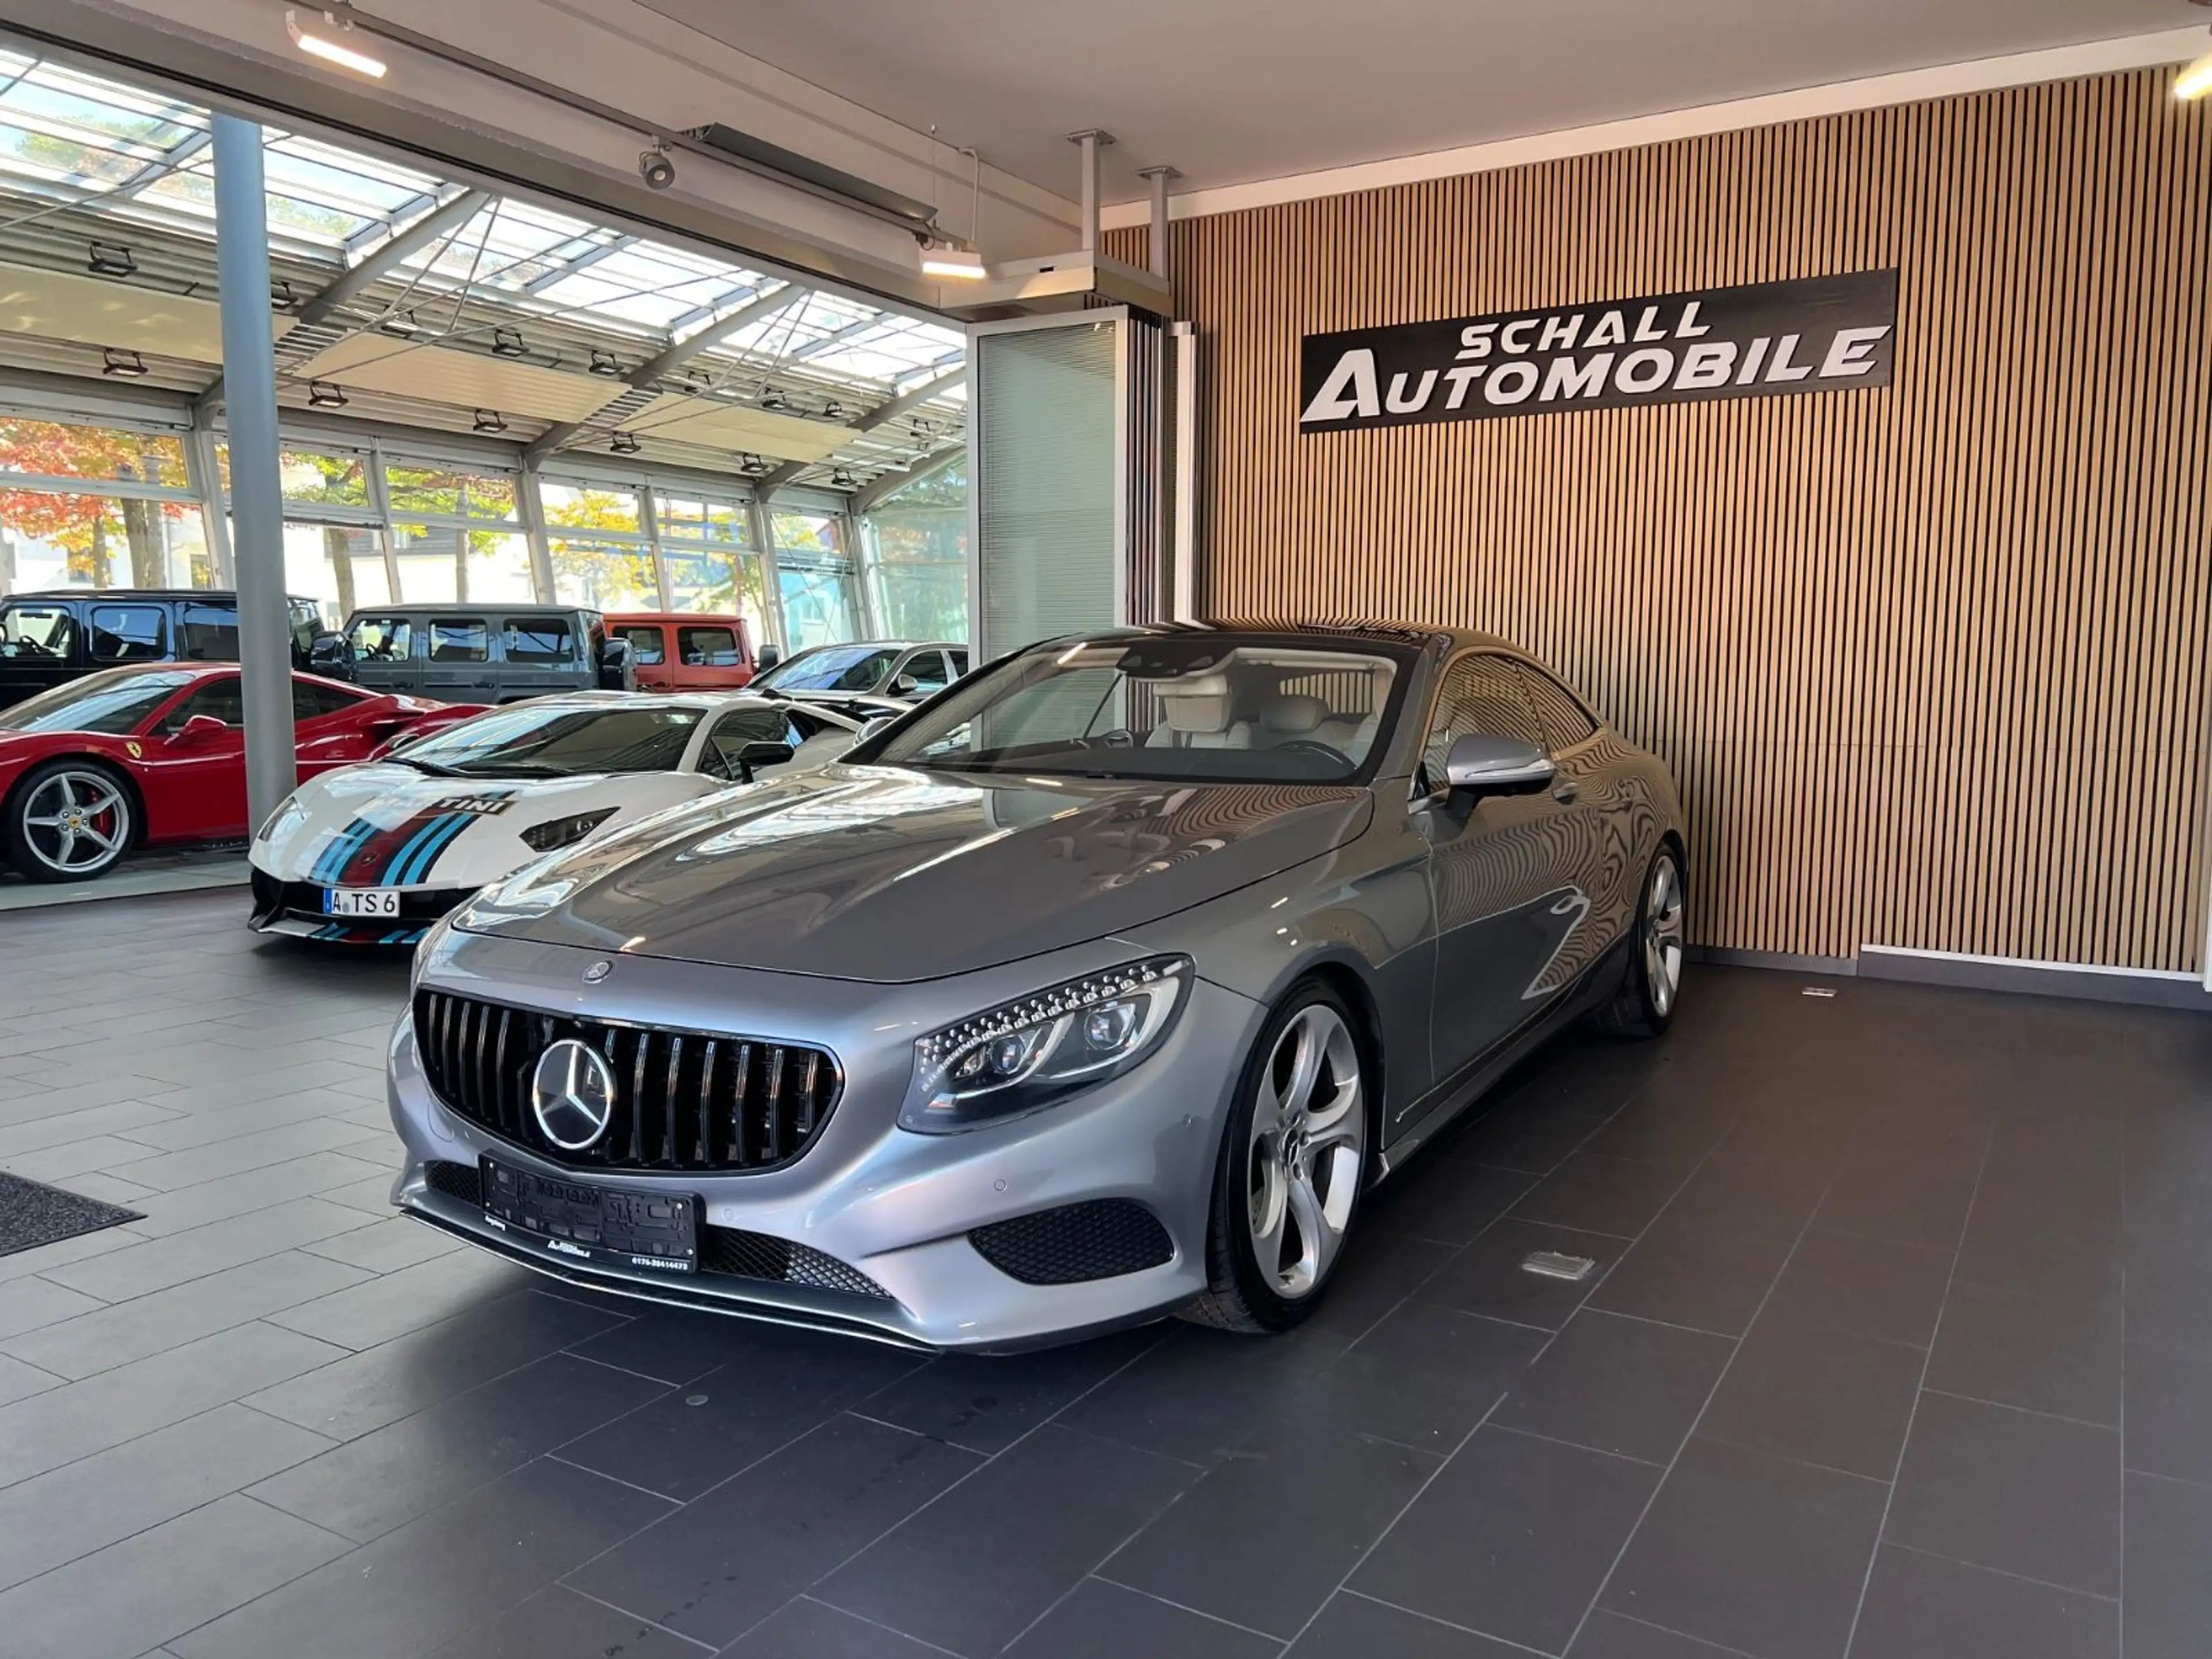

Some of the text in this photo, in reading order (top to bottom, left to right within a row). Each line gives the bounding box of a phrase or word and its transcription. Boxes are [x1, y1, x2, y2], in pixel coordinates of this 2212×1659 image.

[1455, 301, 1713, 361] SCHALL
[1300, 324, 1893, 423] AUTOMOBILE
[332, 892, 396, 914] A TS 6
